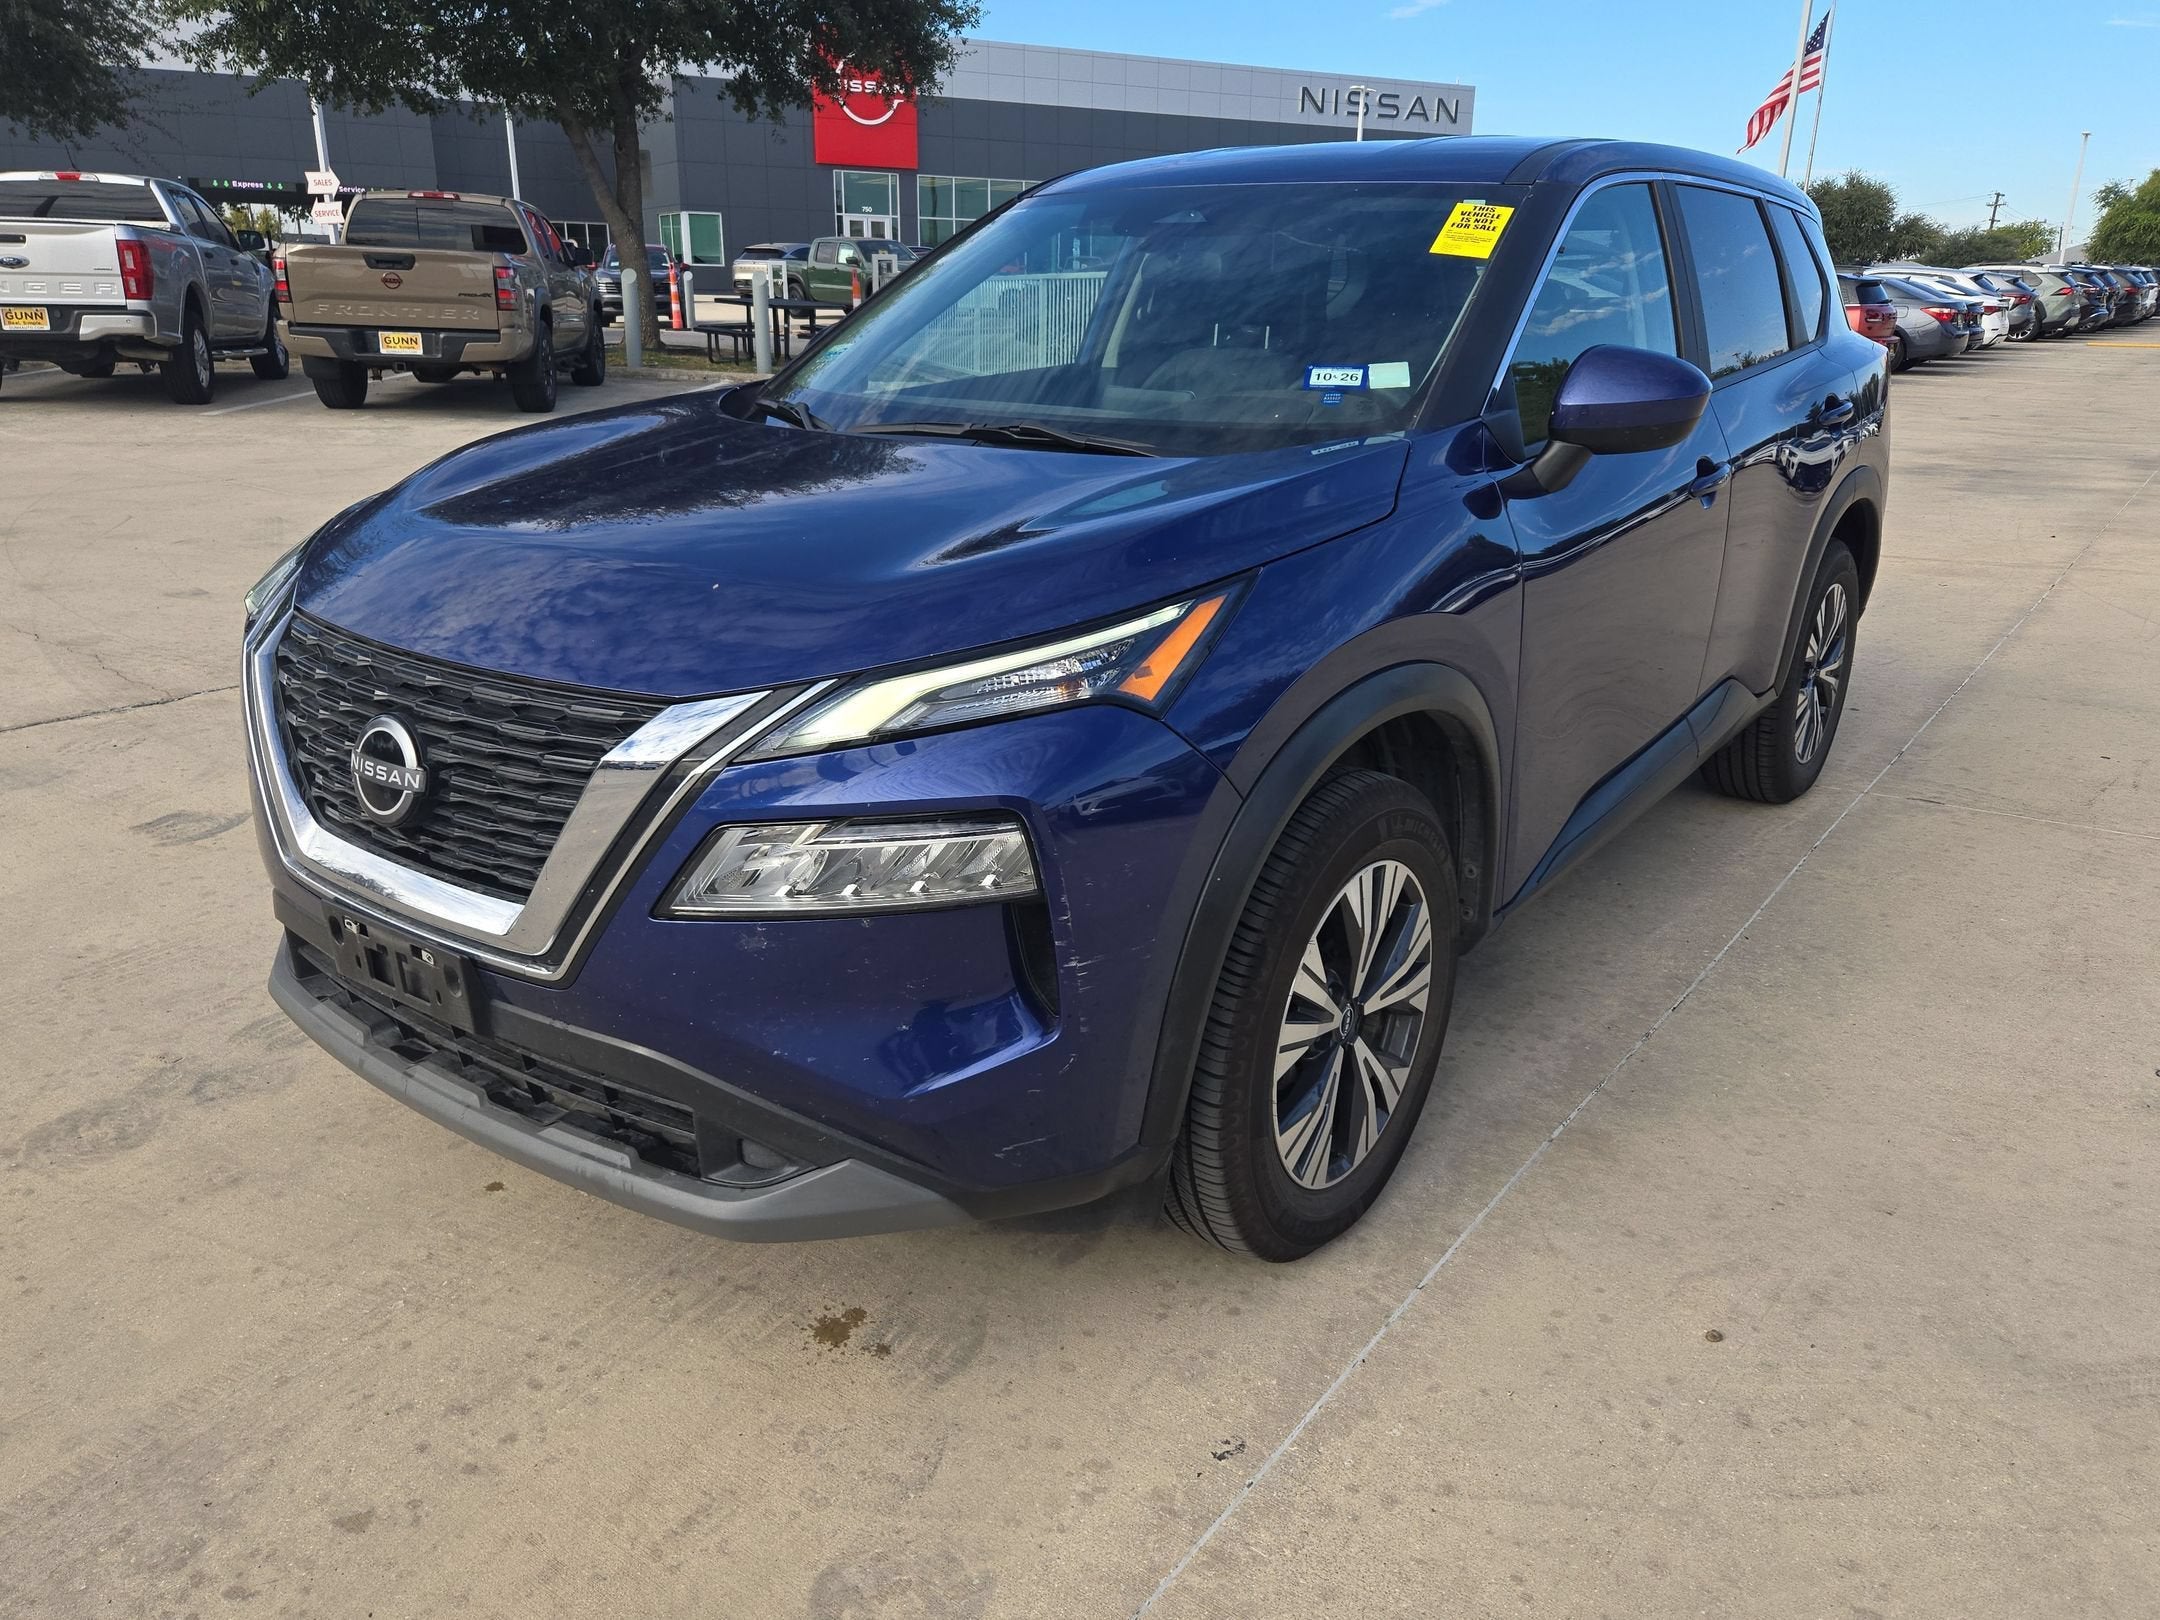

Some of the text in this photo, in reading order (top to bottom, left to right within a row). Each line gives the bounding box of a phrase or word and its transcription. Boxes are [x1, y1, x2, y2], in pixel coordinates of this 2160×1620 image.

[1299, 86, 1460, 124] NISSAN
[231, 180, 264, 189] Express
[313, 178, 333, 187] SALES
[314, 209, 341, 218] SERVICE
[1473, 205, 1497, 213] THIS
[1460, 210, 1503, 220] VEHICLE
[1473, 224, 1499, 232] SALE
[5, 311, 44, 321] GUNN
[313, 303, 480, 321] FRONTIER
[383, 336, 419, 346] GUNN
[1315, 372, 1359, 382] 10 26
[350, 751, 421, 789] NISSAN
